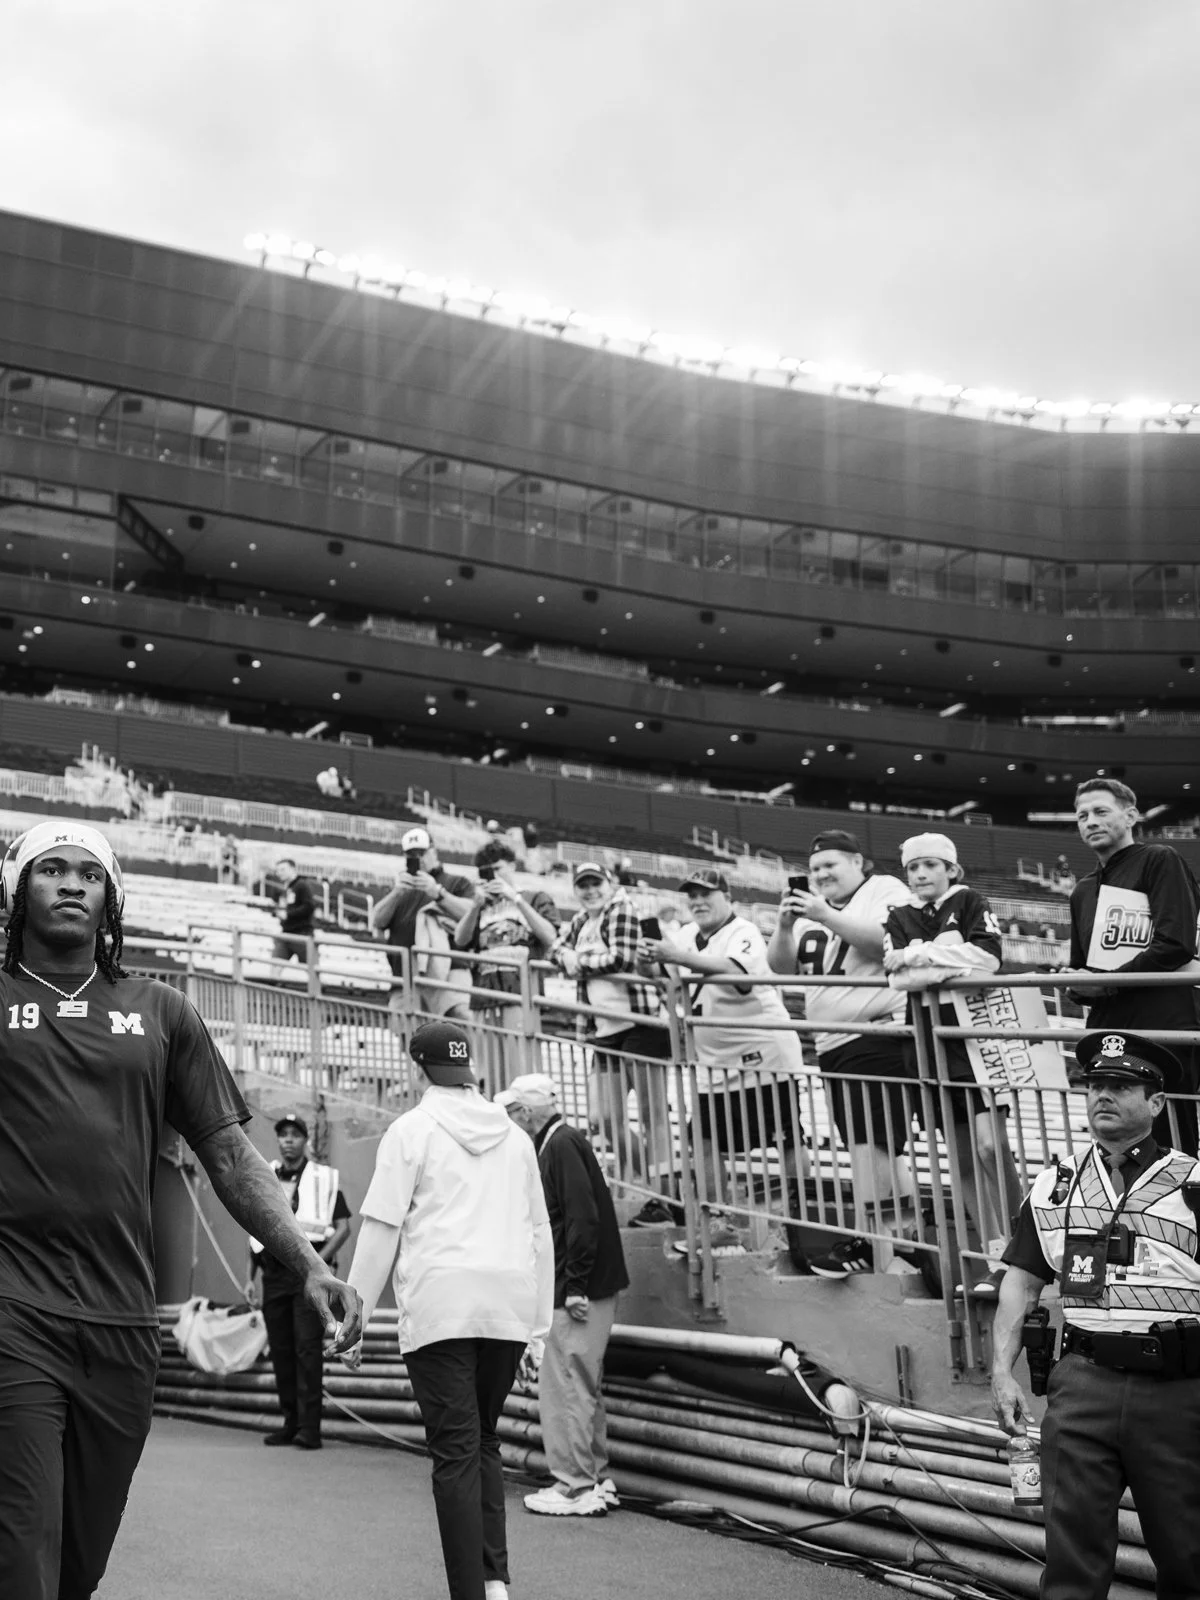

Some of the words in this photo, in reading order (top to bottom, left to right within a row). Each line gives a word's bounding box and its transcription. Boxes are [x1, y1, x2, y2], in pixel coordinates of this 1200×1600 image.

[1101, 905, 1154, 950] 3RD
[741, 940, 751, 955] 2
[8, 1002, 40, 1029] 19
[56, 1000, 88, 1018] 19
[107, 1011, 145, 1036] M
[449, 1041, 468, 1057] M
[1071, 1254, 1094, 1274] M
